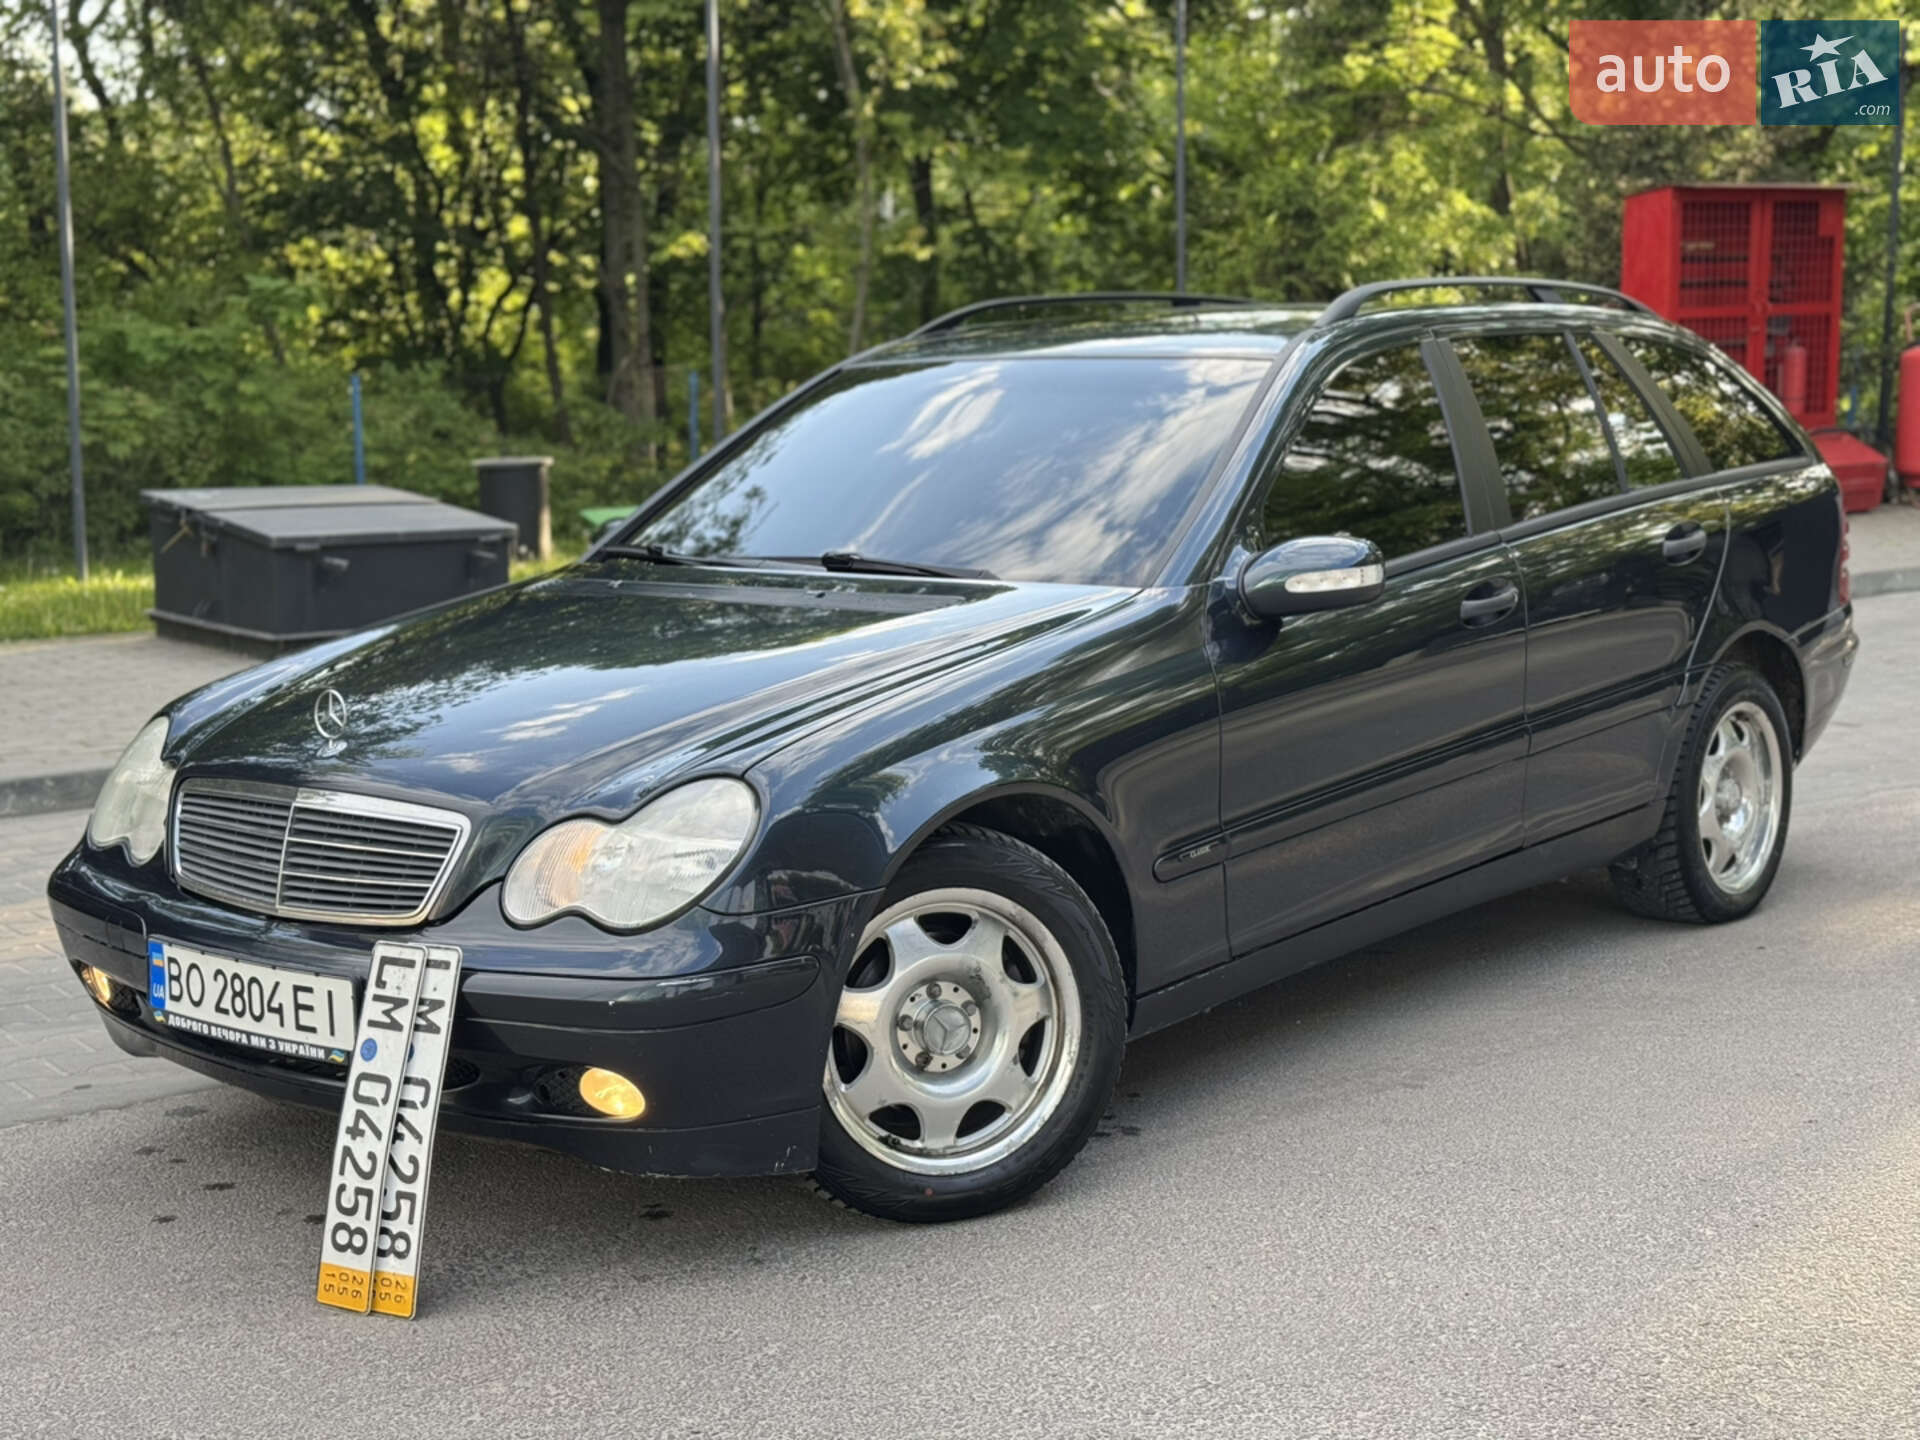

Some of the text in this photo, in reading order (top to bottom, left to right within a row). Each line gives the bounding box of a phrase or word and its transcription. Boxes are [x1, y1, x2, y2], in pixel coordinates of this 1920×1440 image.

[152, 984, 165, 999] UA
[167, 956, 335, 1036] BO 2804 EI
[167, 1013, 209, 1035] ДОБРОГО
[210, 1025, 249, 1045] ВЕЧОРА
[250, 1035, 267, 1048] МИ
[278, 1041, 326, 1059] УКРАЇНИ
[331, 955, 416, 1256] LM 04258
